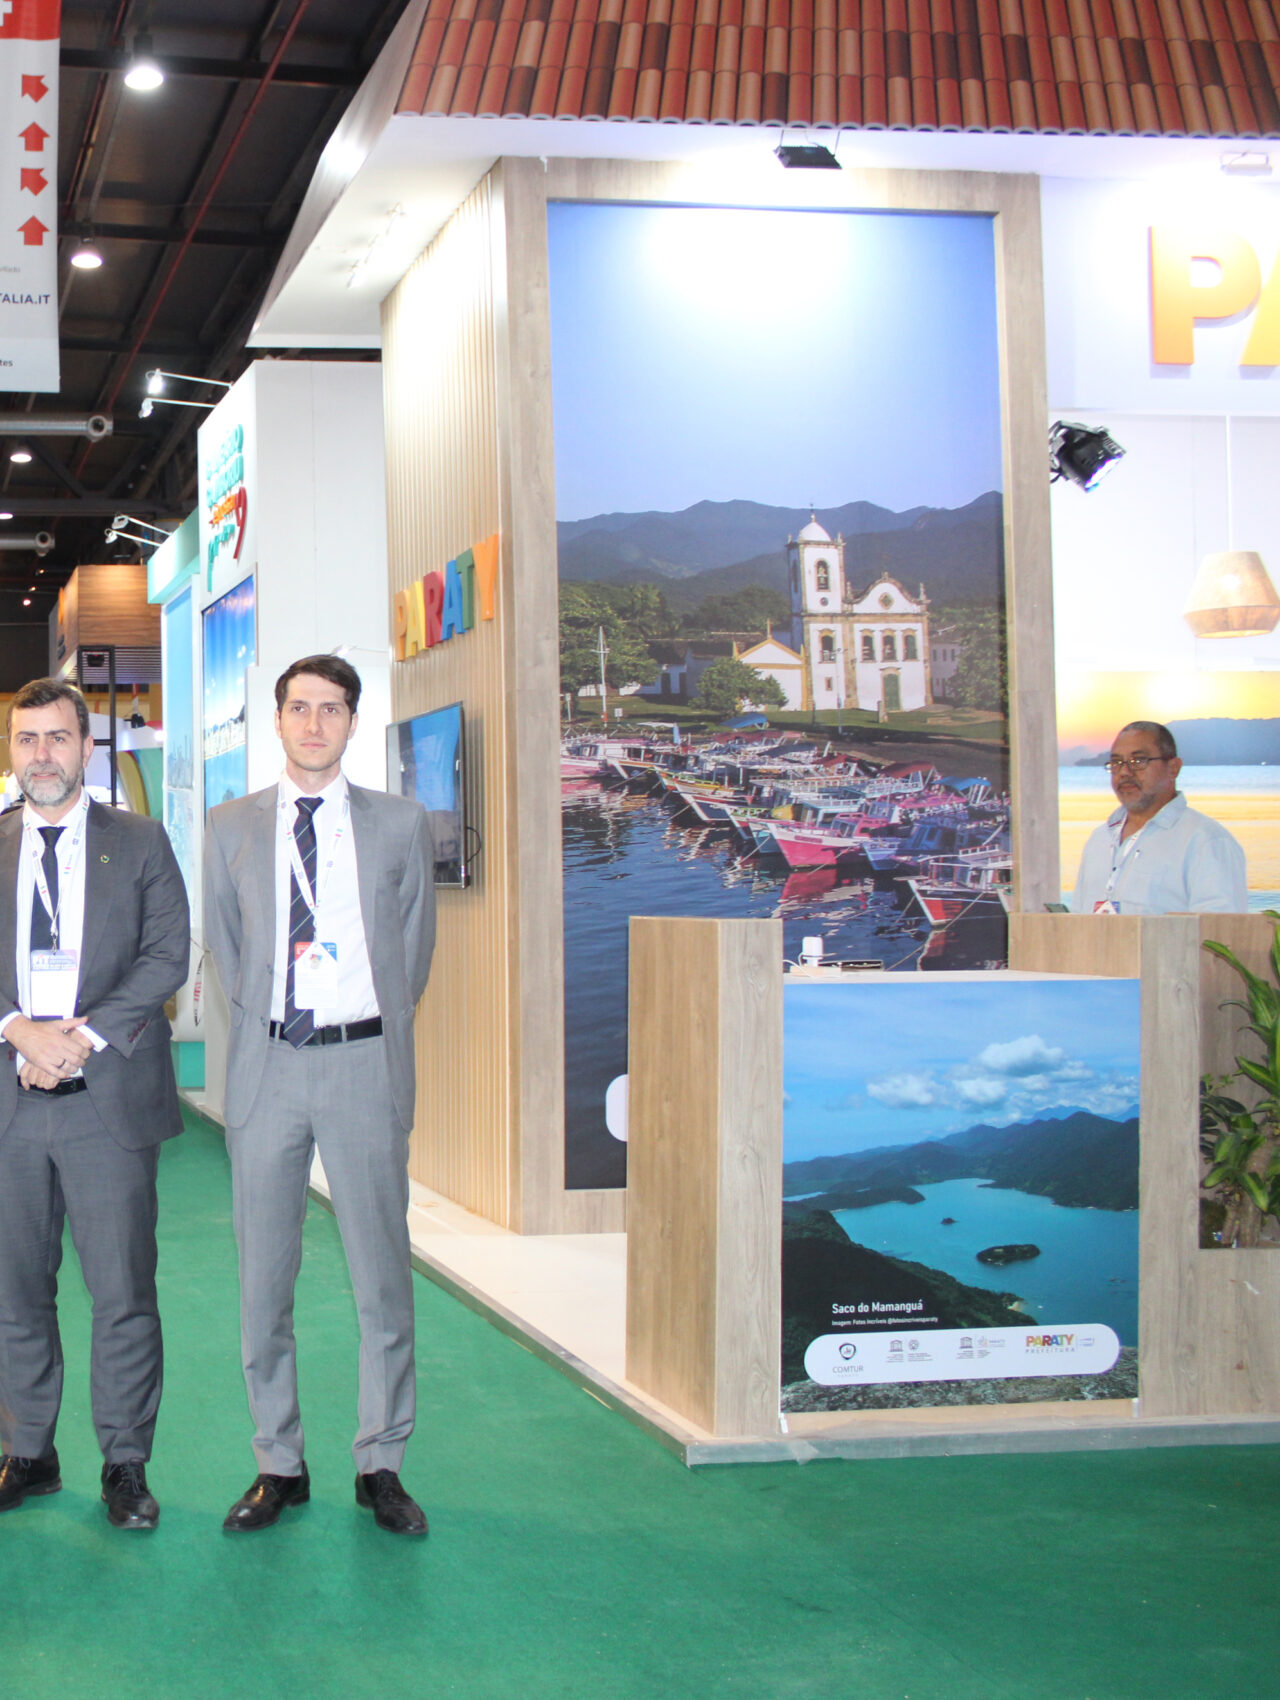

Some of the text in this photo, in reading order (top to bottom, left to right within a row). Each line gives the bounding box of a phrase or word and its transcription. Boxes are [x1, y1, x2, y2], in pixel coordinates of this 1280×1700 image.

[394, 533, 500, 662] PARATY
[831, 1298, 923, 1314] Saco do Mamanguá
[1025, 1333, 1075, 1348] PARATY
[832, 1365, 864, 1374] COMTUR
